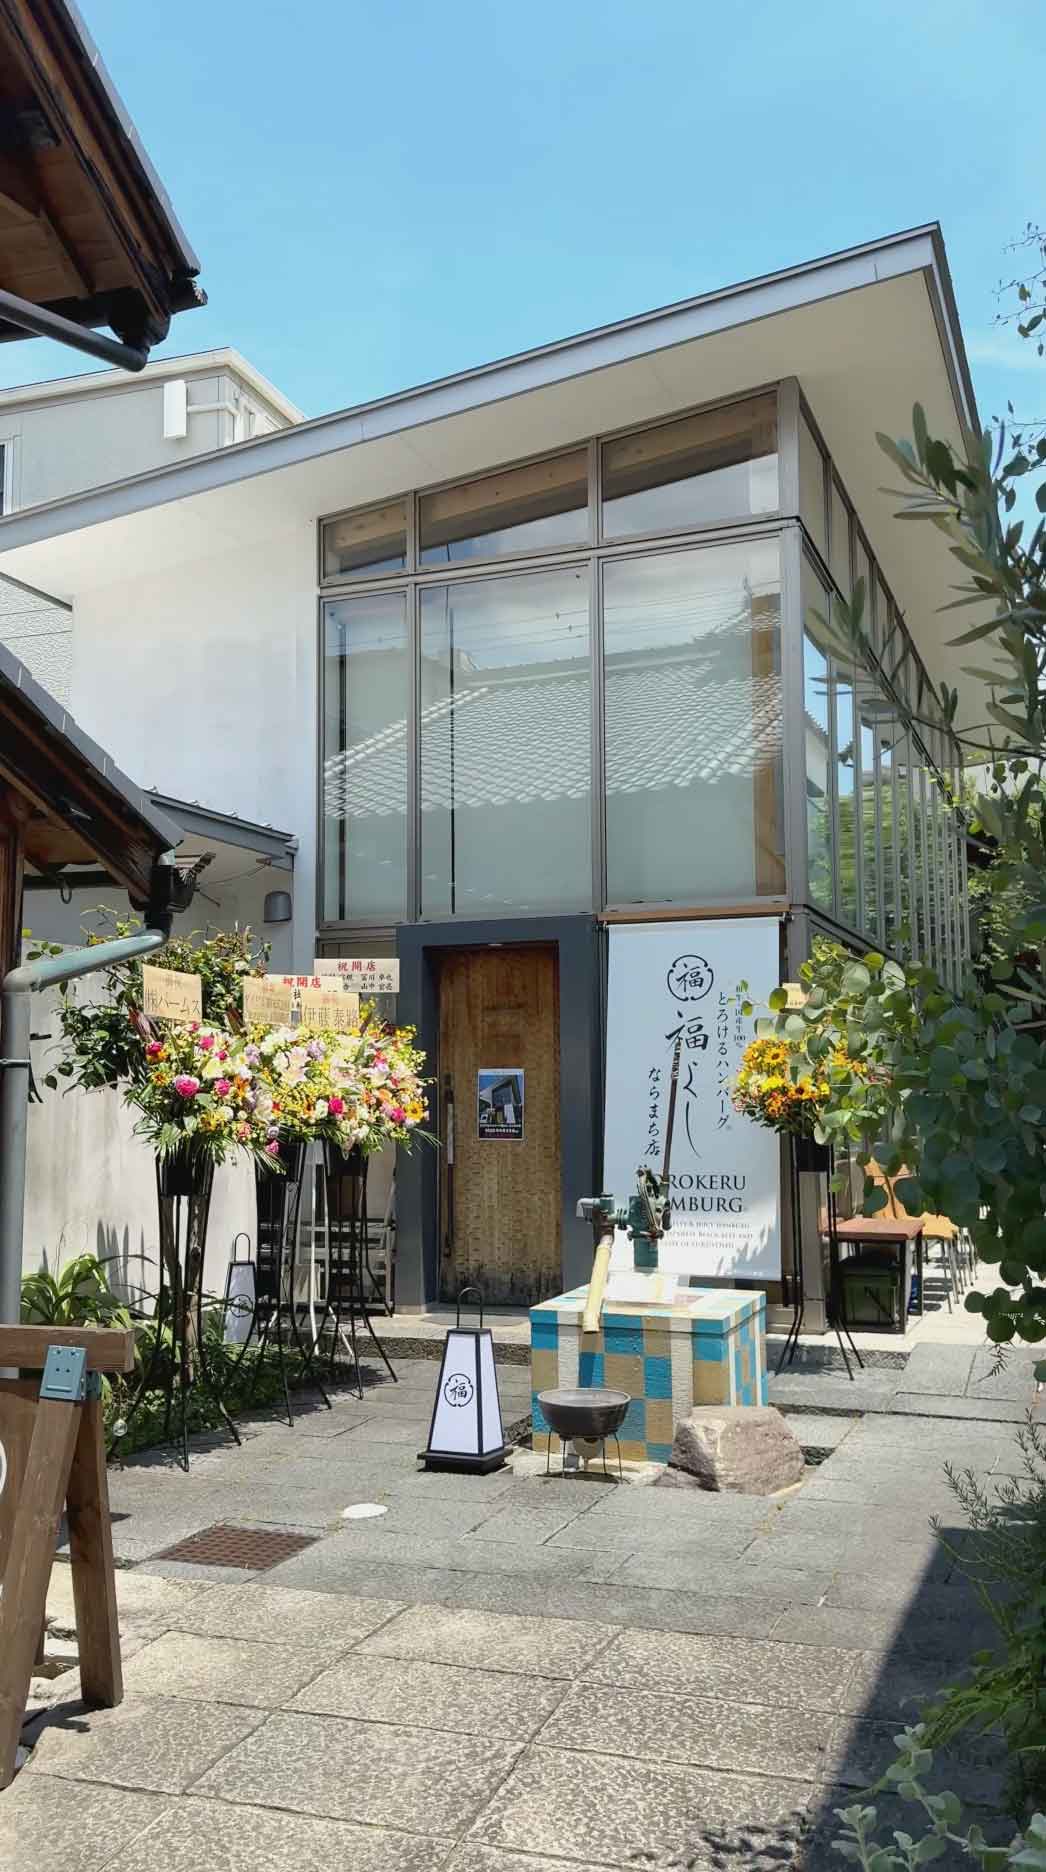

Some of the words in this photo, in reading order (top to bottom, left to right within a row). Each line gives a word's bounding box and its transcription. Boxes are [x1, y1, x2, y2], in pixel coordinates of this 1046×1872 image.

[338, 960, 376, 972] 祝開店
[676, 963, 705, 992] 福
[716, 991, 729, 1130] とろけるハンバーグ
[644, 1068, 661, 1156] ならまち店
[655, 1174, 746, 1191] ROKERU
[670, 1196, 742, 1213] MBURG
[449, 1378, 467, 1400] 福
